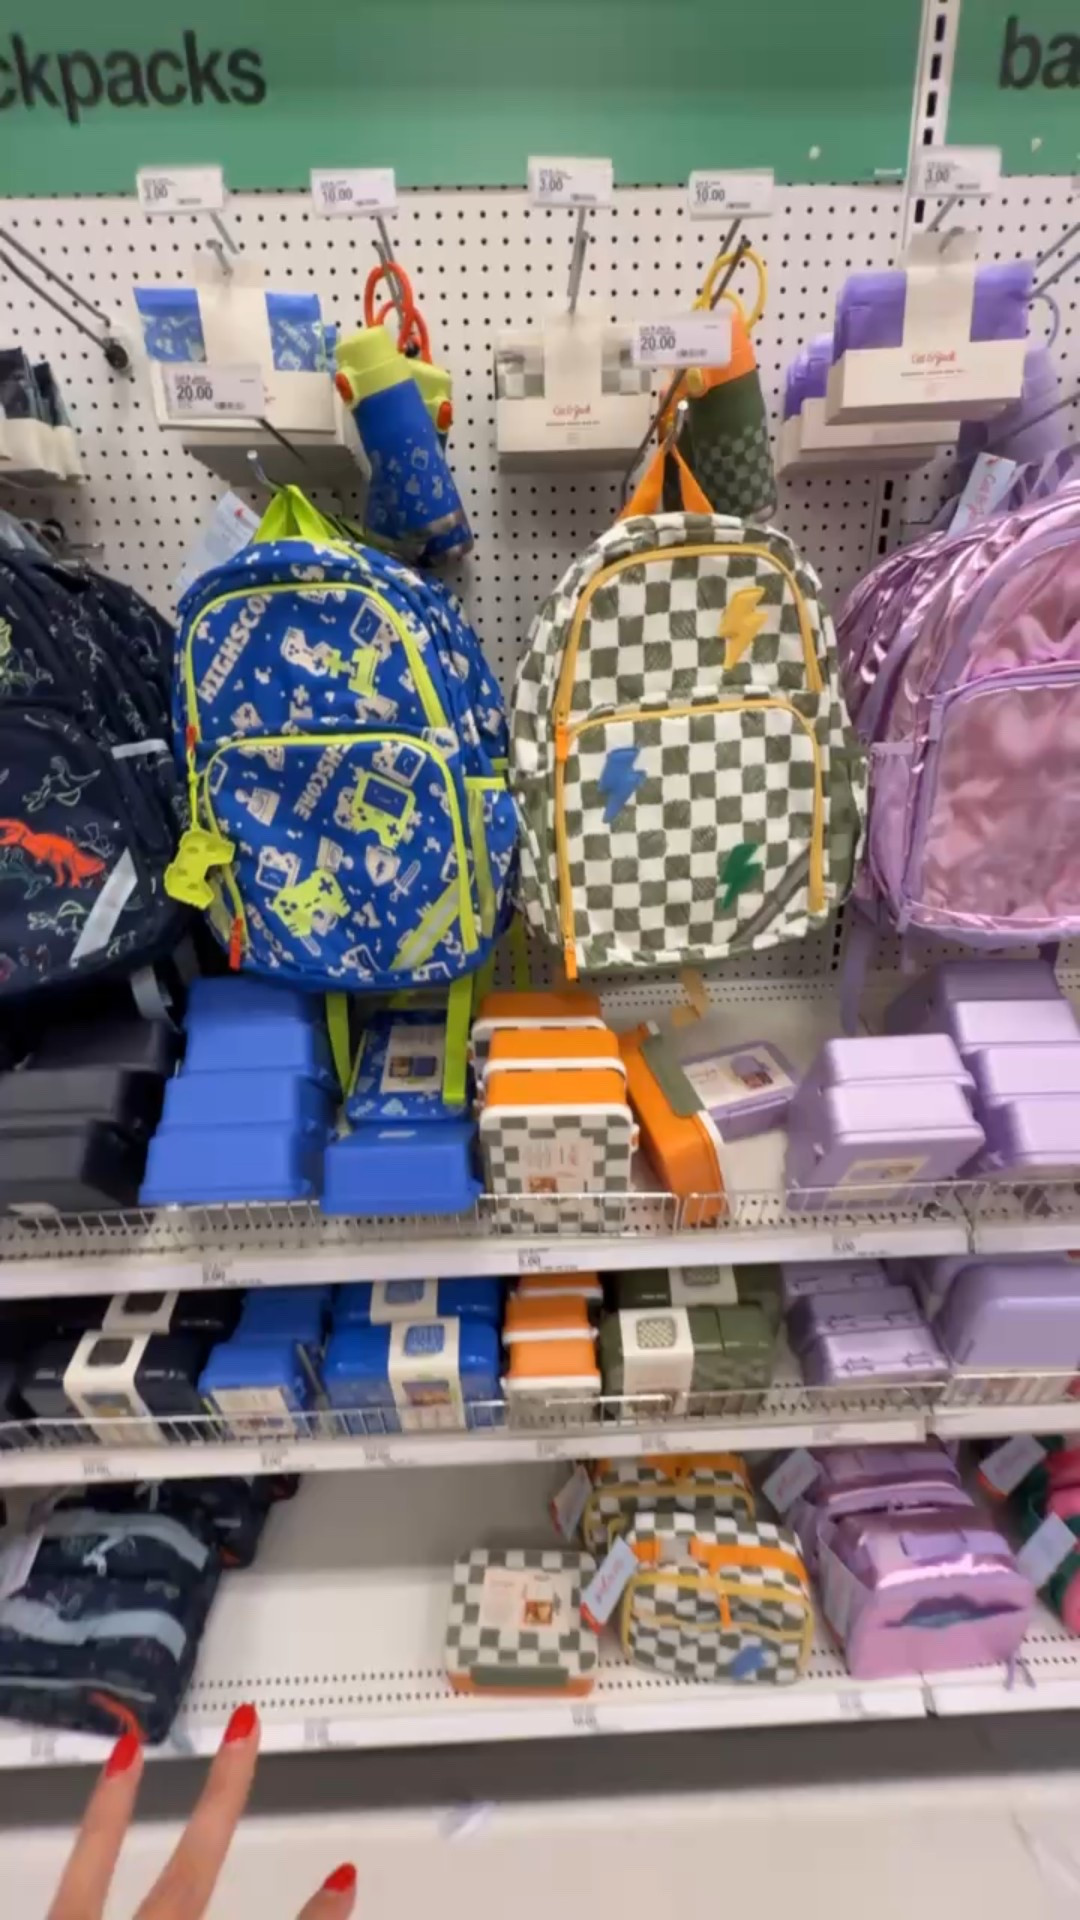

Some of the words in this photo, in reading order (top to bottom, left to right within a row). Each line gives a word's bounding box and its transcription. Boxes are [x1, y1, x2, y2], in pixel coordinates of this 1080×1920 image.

[539, 177, 563, 191] 3.00
[321, 188, 353, 203] 10.00
[695, 189, 725, 201] 10.00
[639, 335, 676, 351] 20.00
[176, 384, 213, 401] 20.00
